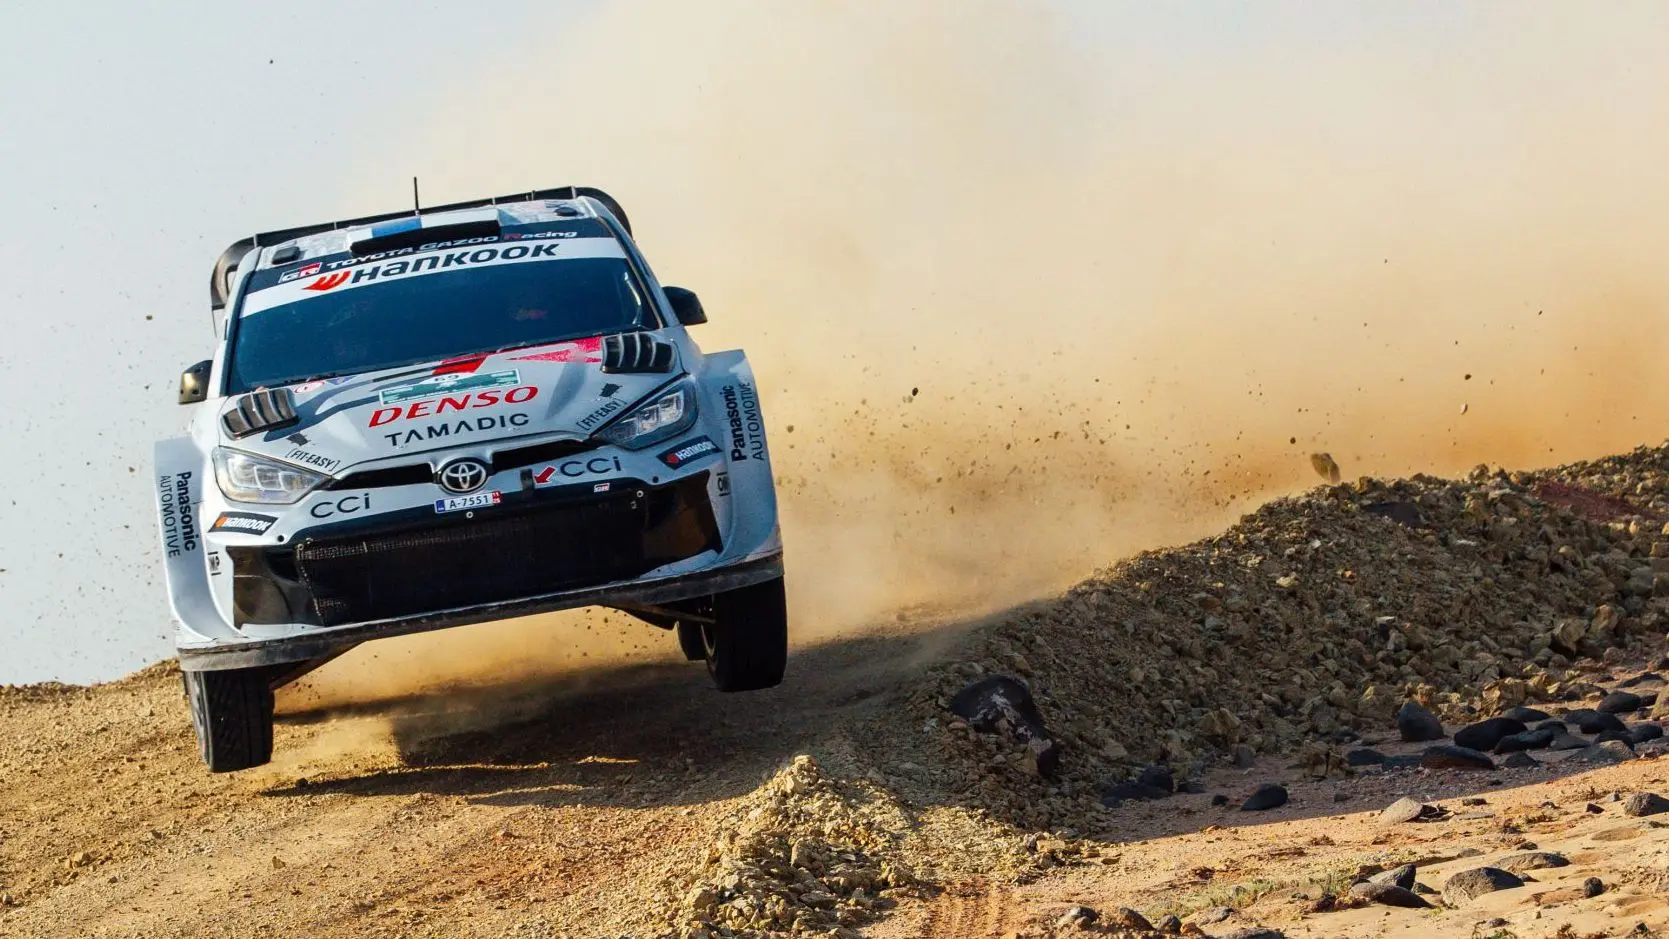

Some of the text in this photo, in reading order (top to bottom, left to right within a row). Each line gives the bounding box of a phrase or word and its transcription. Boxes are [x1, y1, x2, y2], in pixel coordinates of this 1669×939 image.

[327, 247, 413, 269] TOYOTA
[420, 235, 499, 250] GAZOO
[503, 231, 578, 240] Racing
[368, 386, 538, 428] DENSO
[385, 413, 529, 447] TAMADIC
[720, 384, 747, 462] Panasonic
[739, 382, 765, 461] AUTOMOTIVE
[160, 475, 181, 558] AUTOMOTIVE
[176, 471, 197, 551] Panasonic
[449, 495, 489, 508] A-7551
